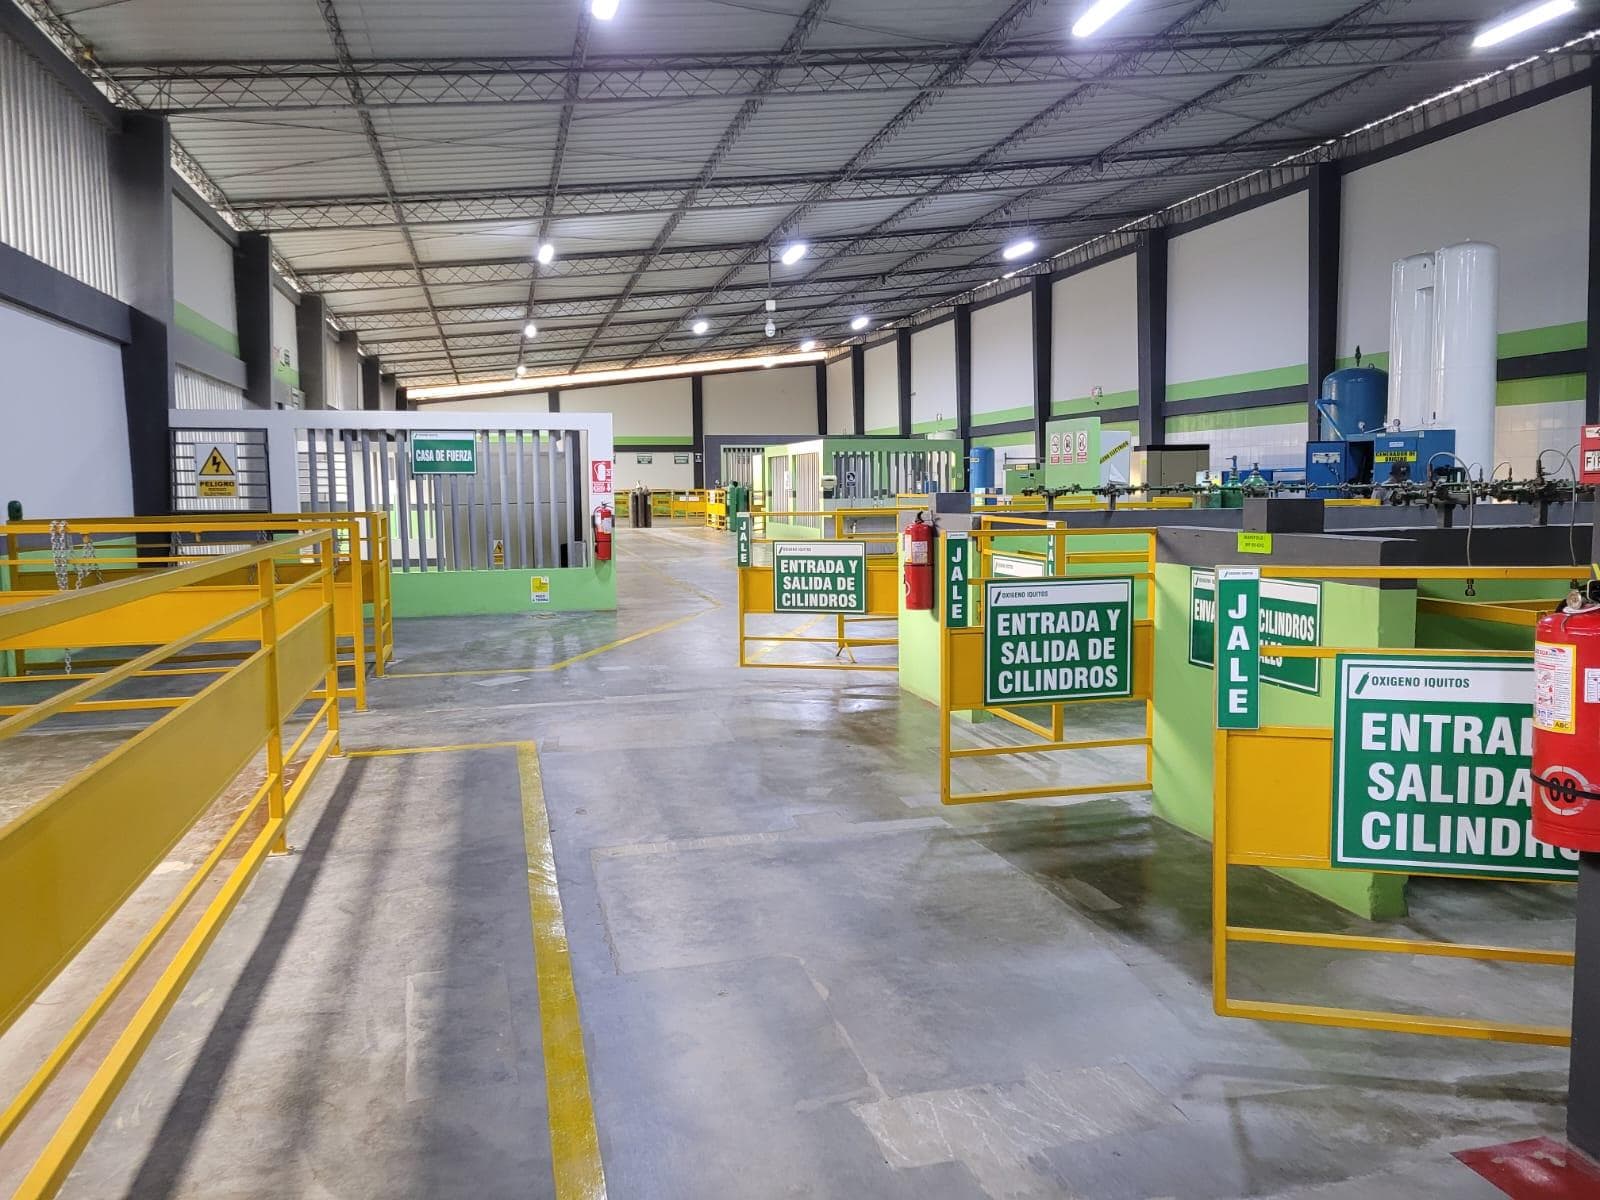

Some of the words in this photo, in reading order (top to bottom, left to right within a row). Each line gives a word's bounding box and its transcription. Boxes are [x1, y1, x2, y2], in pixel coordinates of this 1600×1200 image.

[416, 450, 434, 462] CASA
[436, 450, 445, 462] DE
[447, 450, 473, 462] FUERZA
[740, 521, 748, 563] JALE
[781, 560, 845, 574] ENTRADA
[849, 560, 858, 574] Y
[783, 576, 833, 591] SALIDA
[837, 577, 855, 591] DE
[951, 547, 963, 619] JALE
[1002, 591, 1026, 599] OXIGENO
[782, 593, 857, 608] CILINDROS
[997, 610, 1100, 637] ENTRADA
[1107, 609, 1121, 632] Y
[1259, 608, 1315, 642] CILINDROS
[1001, 639, 1080, 665] SALIDA
[1088, 638, 1116, 660] DE
[1227, 594, 1250, 713] JALE
[998, 665, 1118, 694] CILINDROS
[1371, 675, 1421, 688] OXIGENO
[1423, 677, 1470, 689] IQUITOS
[1555, 721, 1569, 729] ABC
[1367, 762, 1531, 807] SALIDA
